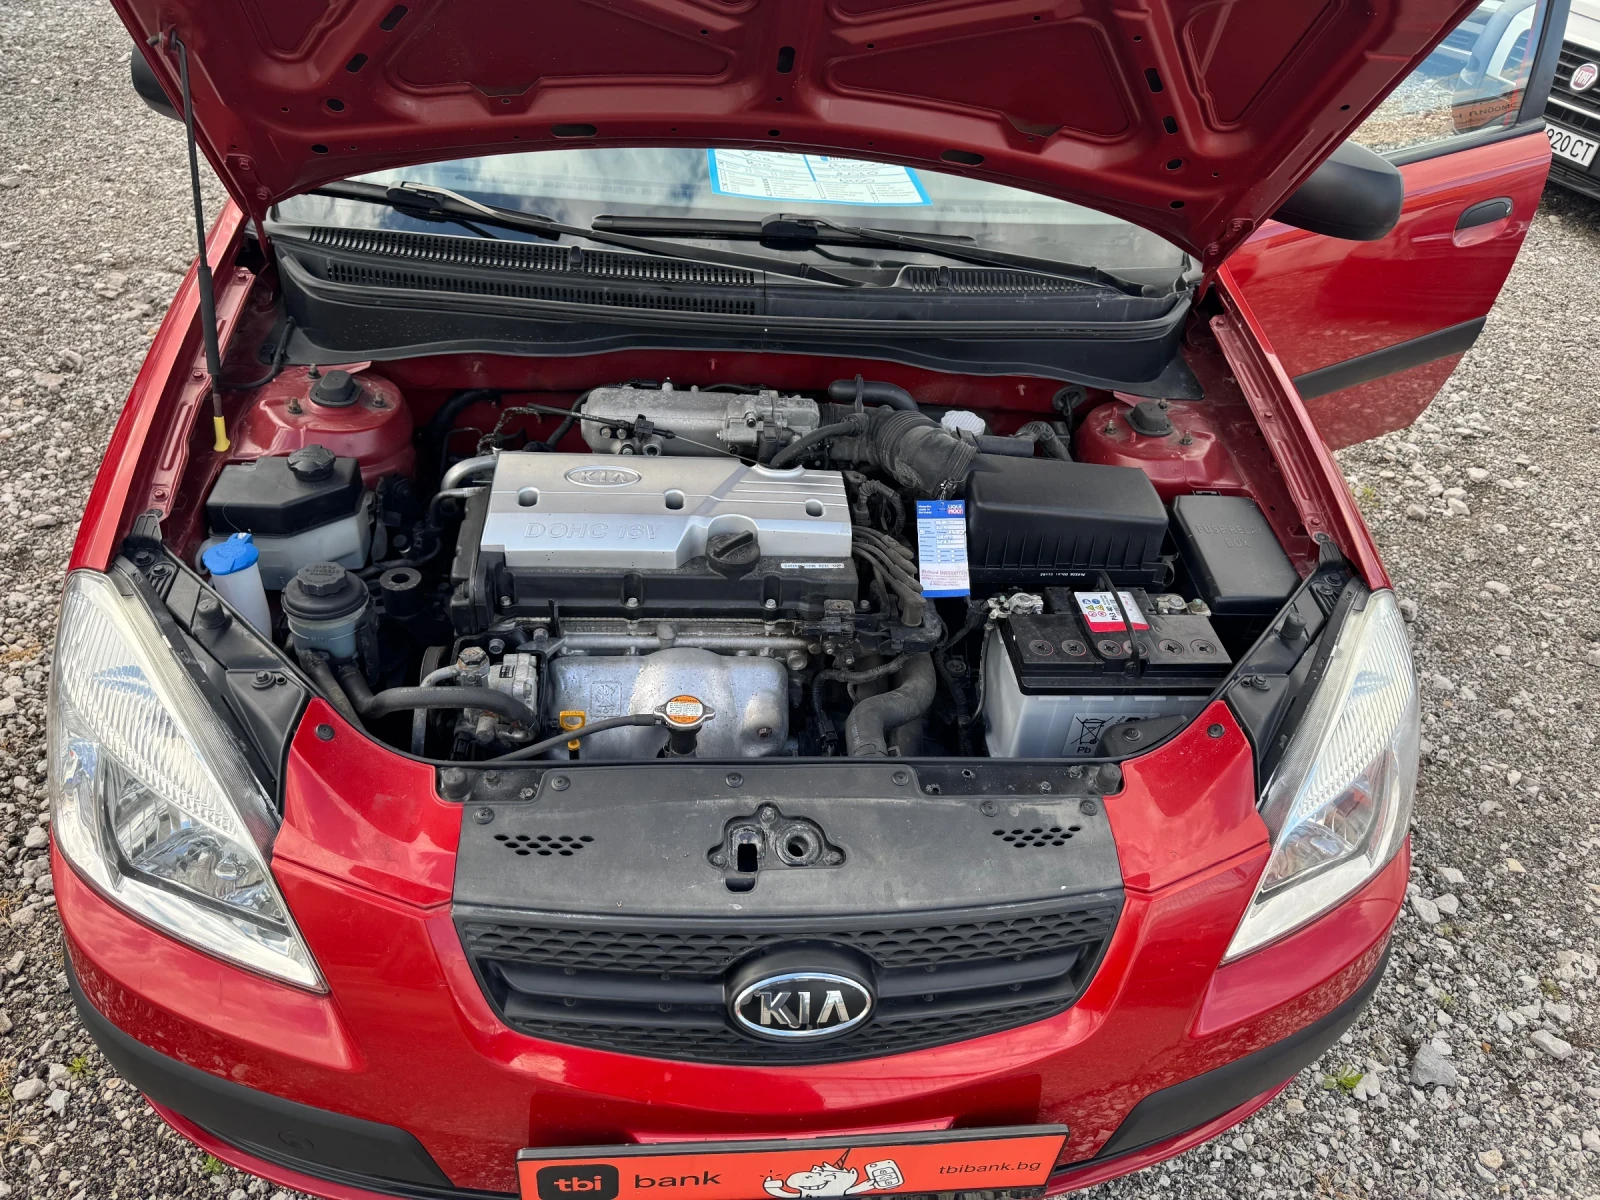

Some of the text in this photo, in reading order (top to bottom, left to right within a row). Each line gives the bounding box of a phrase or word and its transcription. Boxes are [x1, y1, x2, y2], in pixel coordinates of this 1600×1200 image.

[577, 470, 628, 483] KIA
[524, 522, 664, 540] DOHC 16V
[1224, 538, 1251, 548] BOX
[1076, 746, 1092, 754] Pb
[759, 989, 850, 1026] KIA
[939, 1161, 1042, 1175] tbibank.bg
[553, 1171, 723, 1192] tbi bank
